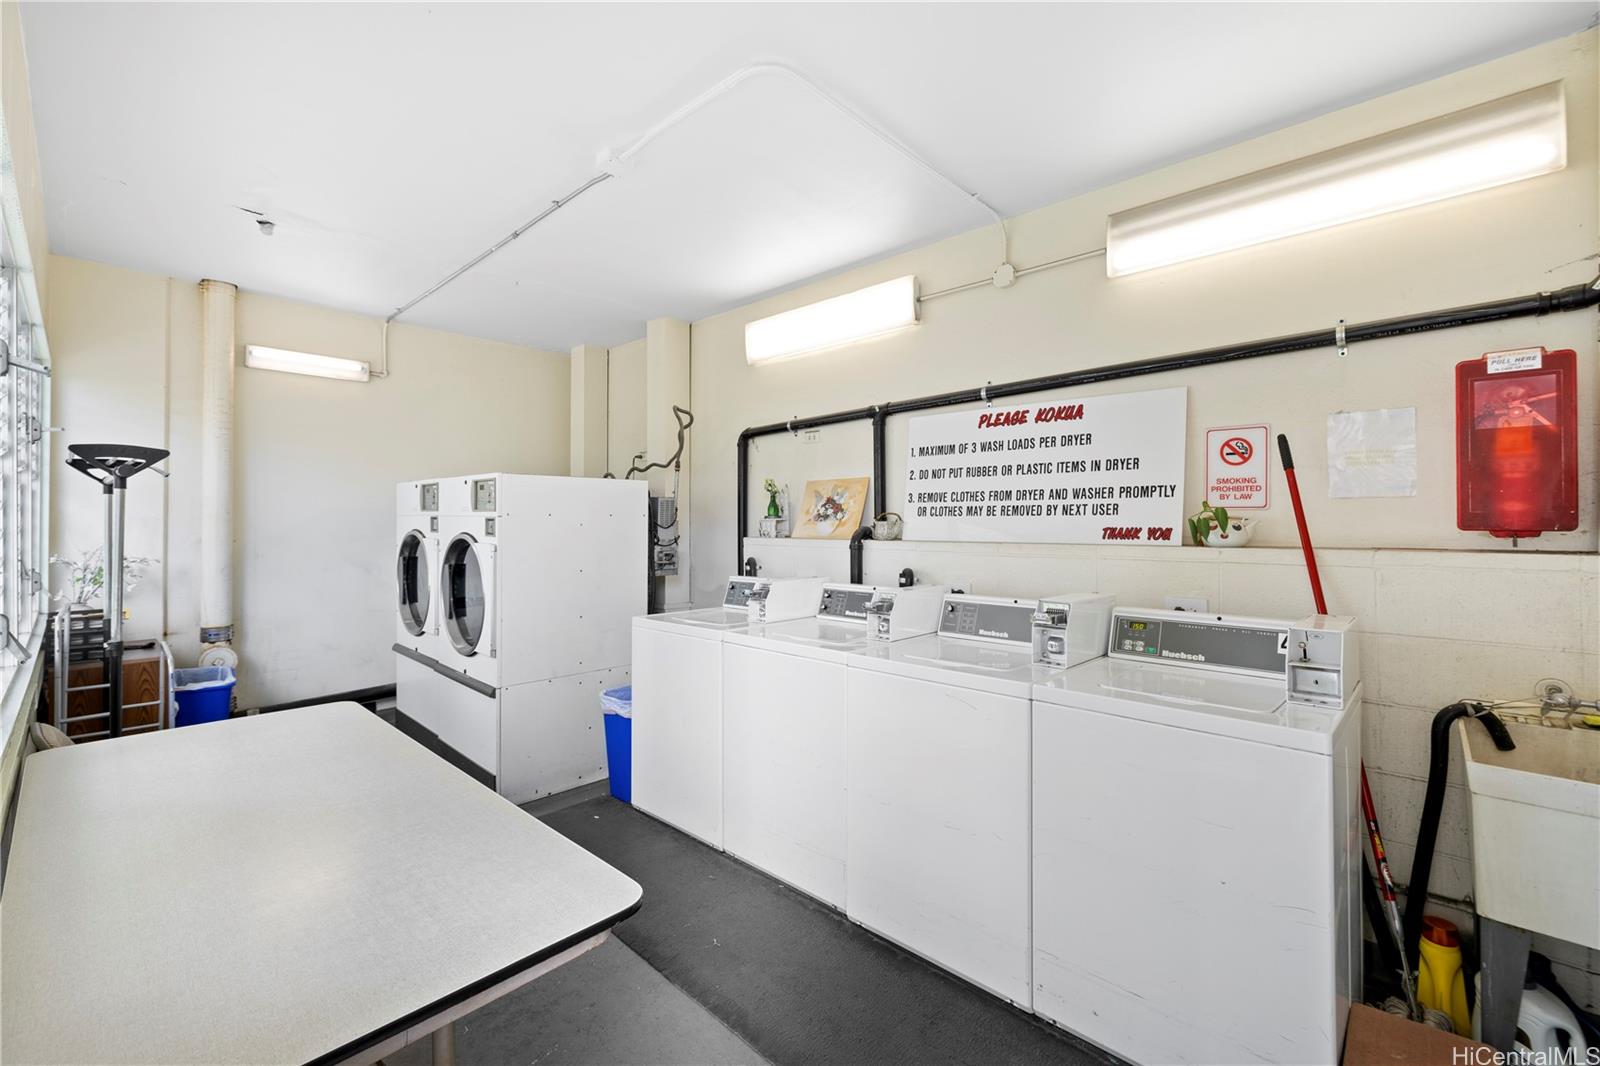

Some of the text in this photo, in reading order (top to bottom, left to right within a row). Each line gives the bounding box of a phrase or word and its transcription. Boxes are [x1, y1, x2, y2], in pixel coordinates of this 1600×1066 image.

[1514, 354, 1537, 363] HERE
[977, 403, 1084, 430] PLEASE KOKUA
[911, 433, 1093, 458] 1. MAXIMUM OF 3 WASH LOADS PER DRYER
[909, 457, 1140, 481] 2. DO NOT PUT RUBBER OR PLASTIC ITEMS IN DRYER
[1216, 477, 1257, 485] SMOKING
[908, 484, 1177, 504] 3. REMOVE CLOTHES FROM DRYER AND WASHER PROMPTLY
[1211, 485, 1262, 493] PROHIBITED
[1219, 493, 1253, 501] BY LAW
[917, 503, 1119, 518] OR CLOTHES MAY BE REMOVED BY NEXT USER
[1102, 526, 1173, 541] THANK YOU
[1162, 650, 1205, 661] Huebsch
